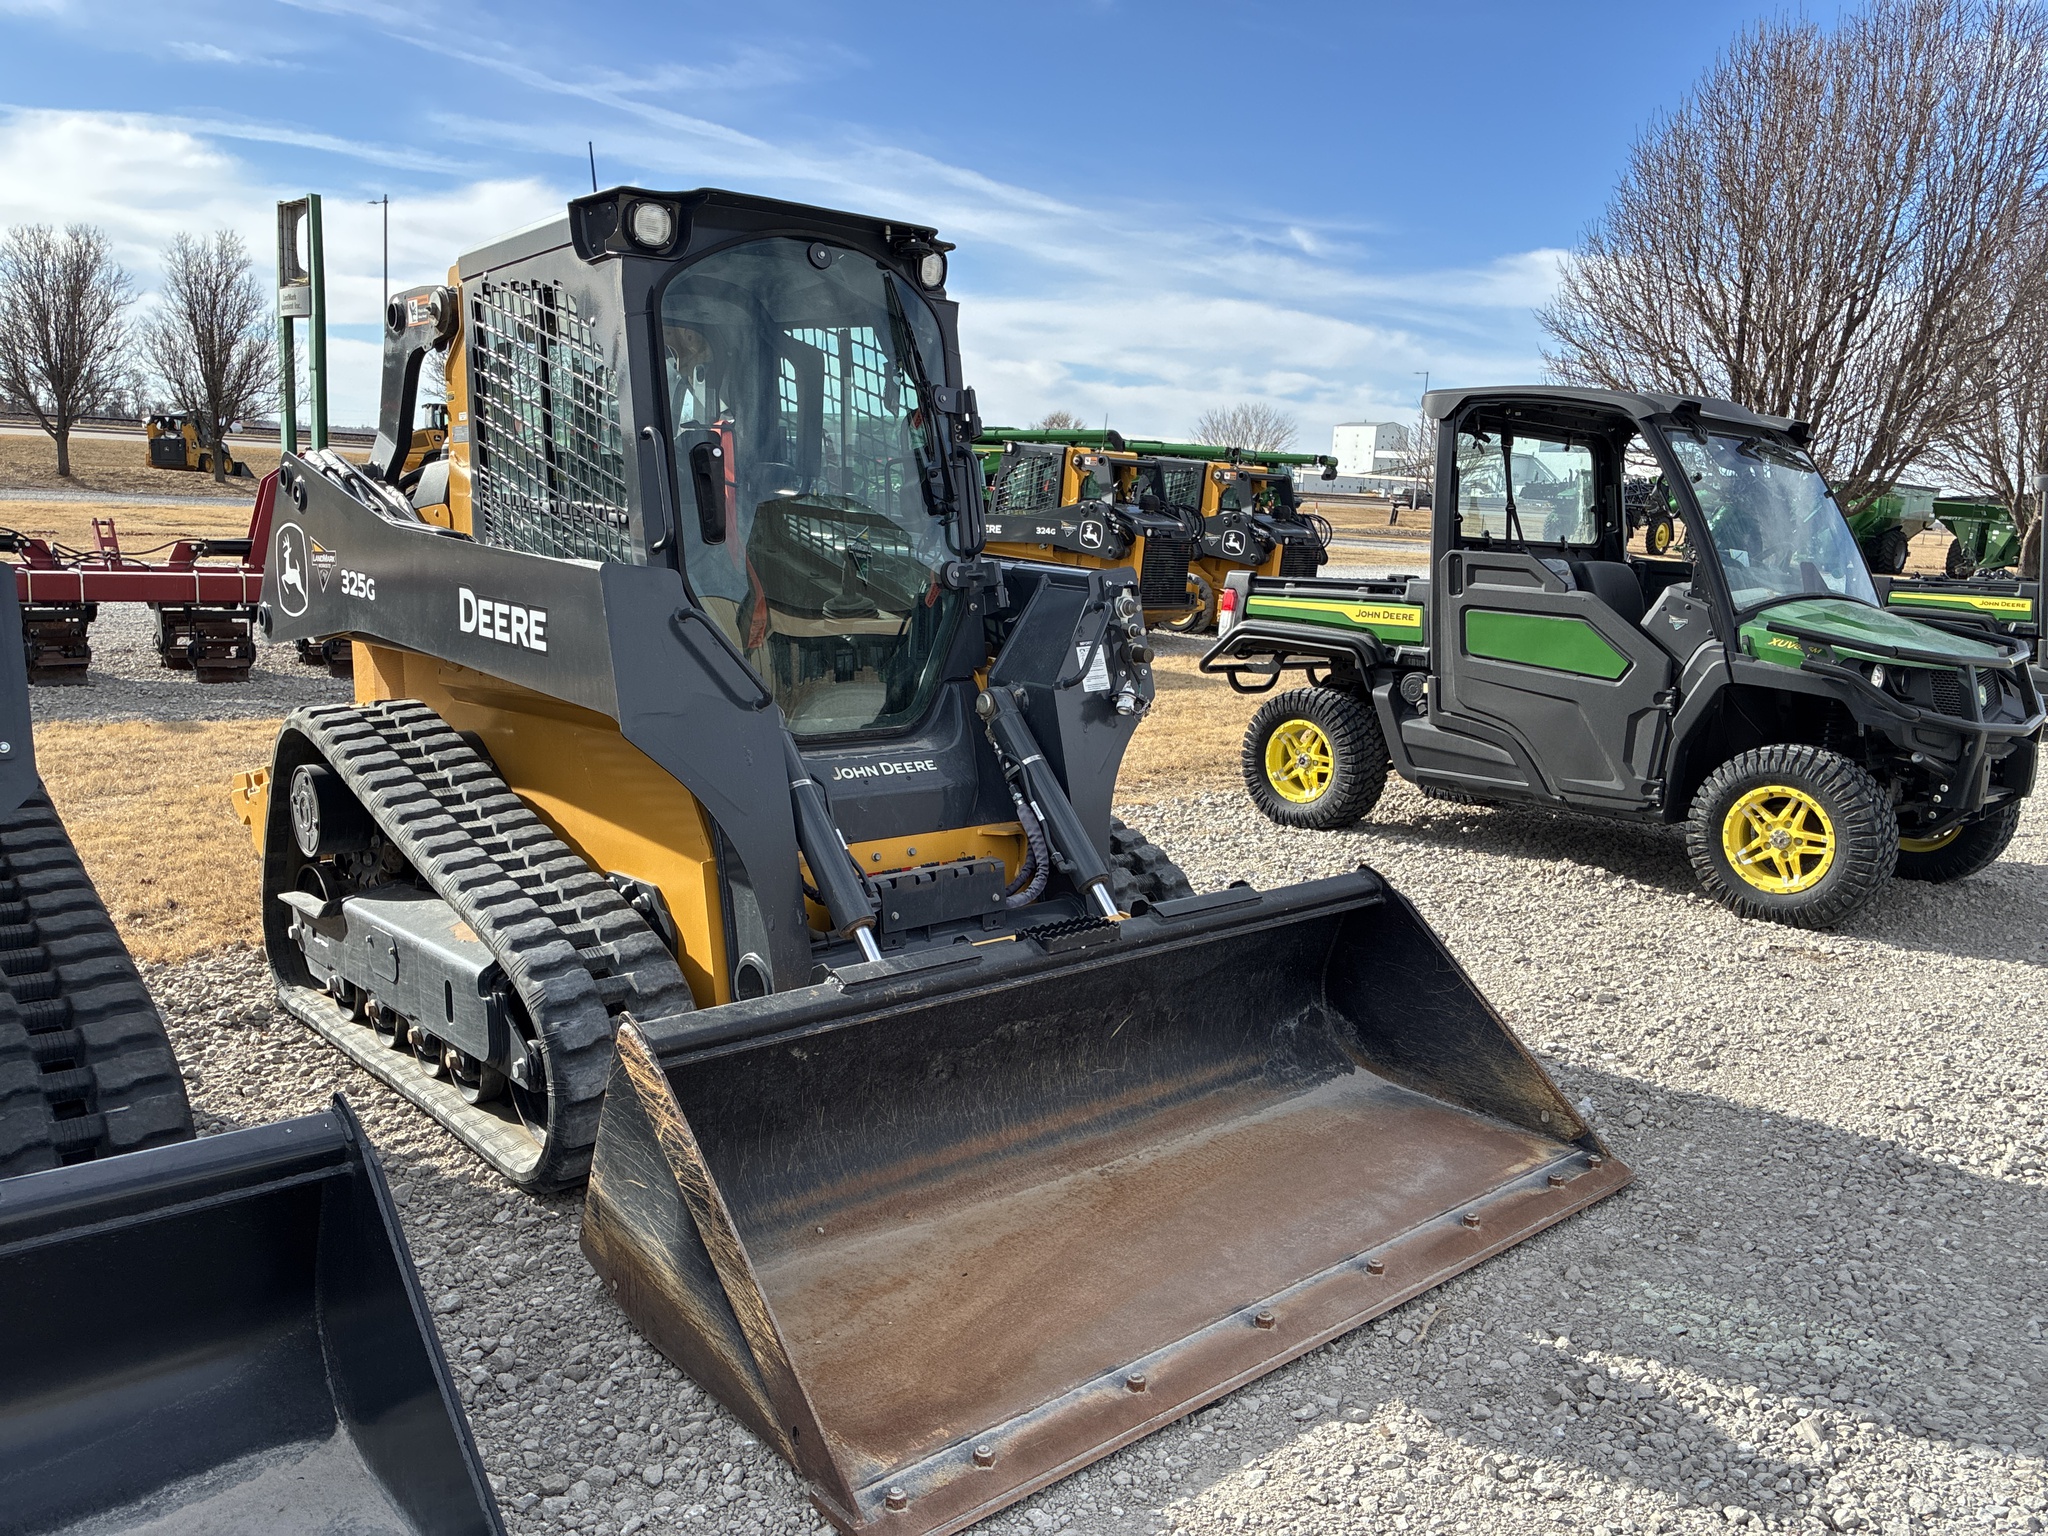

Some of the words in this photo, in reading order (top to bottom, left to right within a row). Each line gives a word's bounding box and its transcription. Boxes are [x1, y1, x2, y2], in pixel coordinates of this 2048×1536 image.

[1036, 527, 1056, 535] 324G
[341, 569, 376, 601] 325G
[459, 587, 547, 652] DEERE
[1356, 609, 1380, 619] JOHN
[1382, 611, 1415, 621] DEERE
[833, 766, 879, 781] JOHN
[879, 760, 937, 775] DEERE
